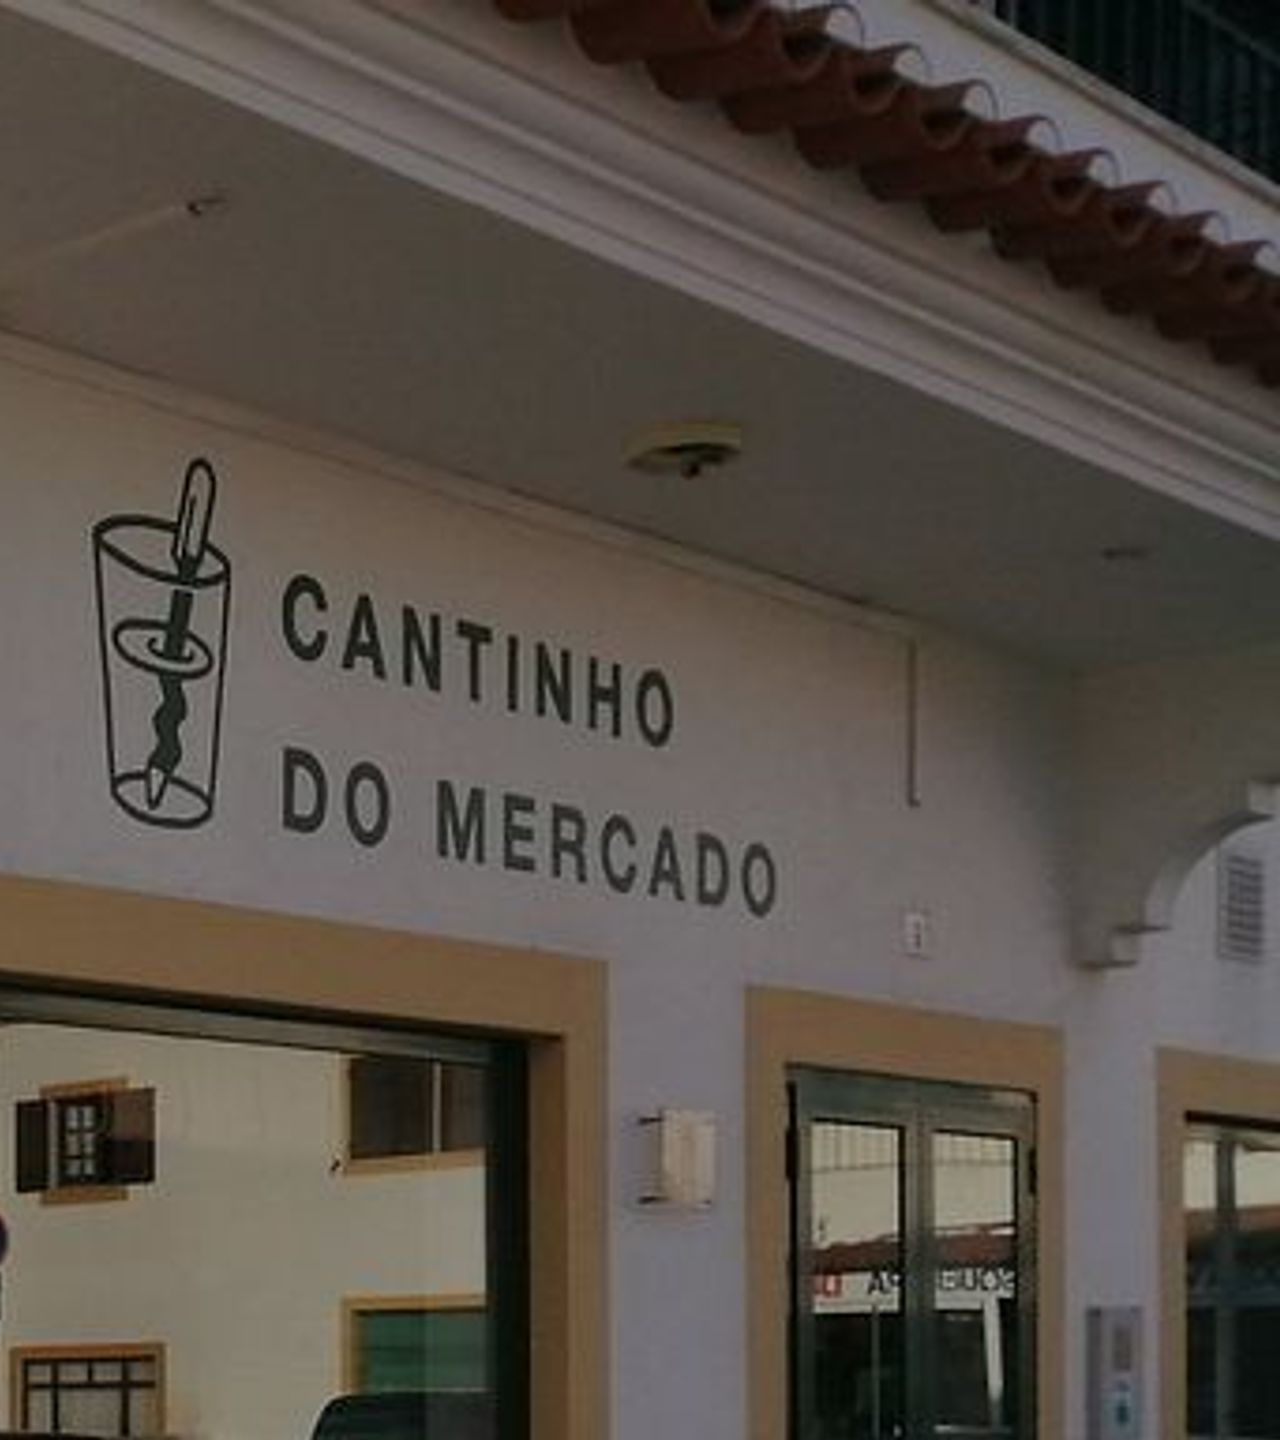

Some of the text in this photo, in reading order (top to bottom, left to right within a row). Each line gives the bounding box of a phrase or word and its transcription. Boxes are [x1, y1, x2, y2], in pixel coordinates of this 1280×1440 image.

[281, 573, 675, 748] CANTINHO
[281, 746, 777, 918] DO MERCADO
